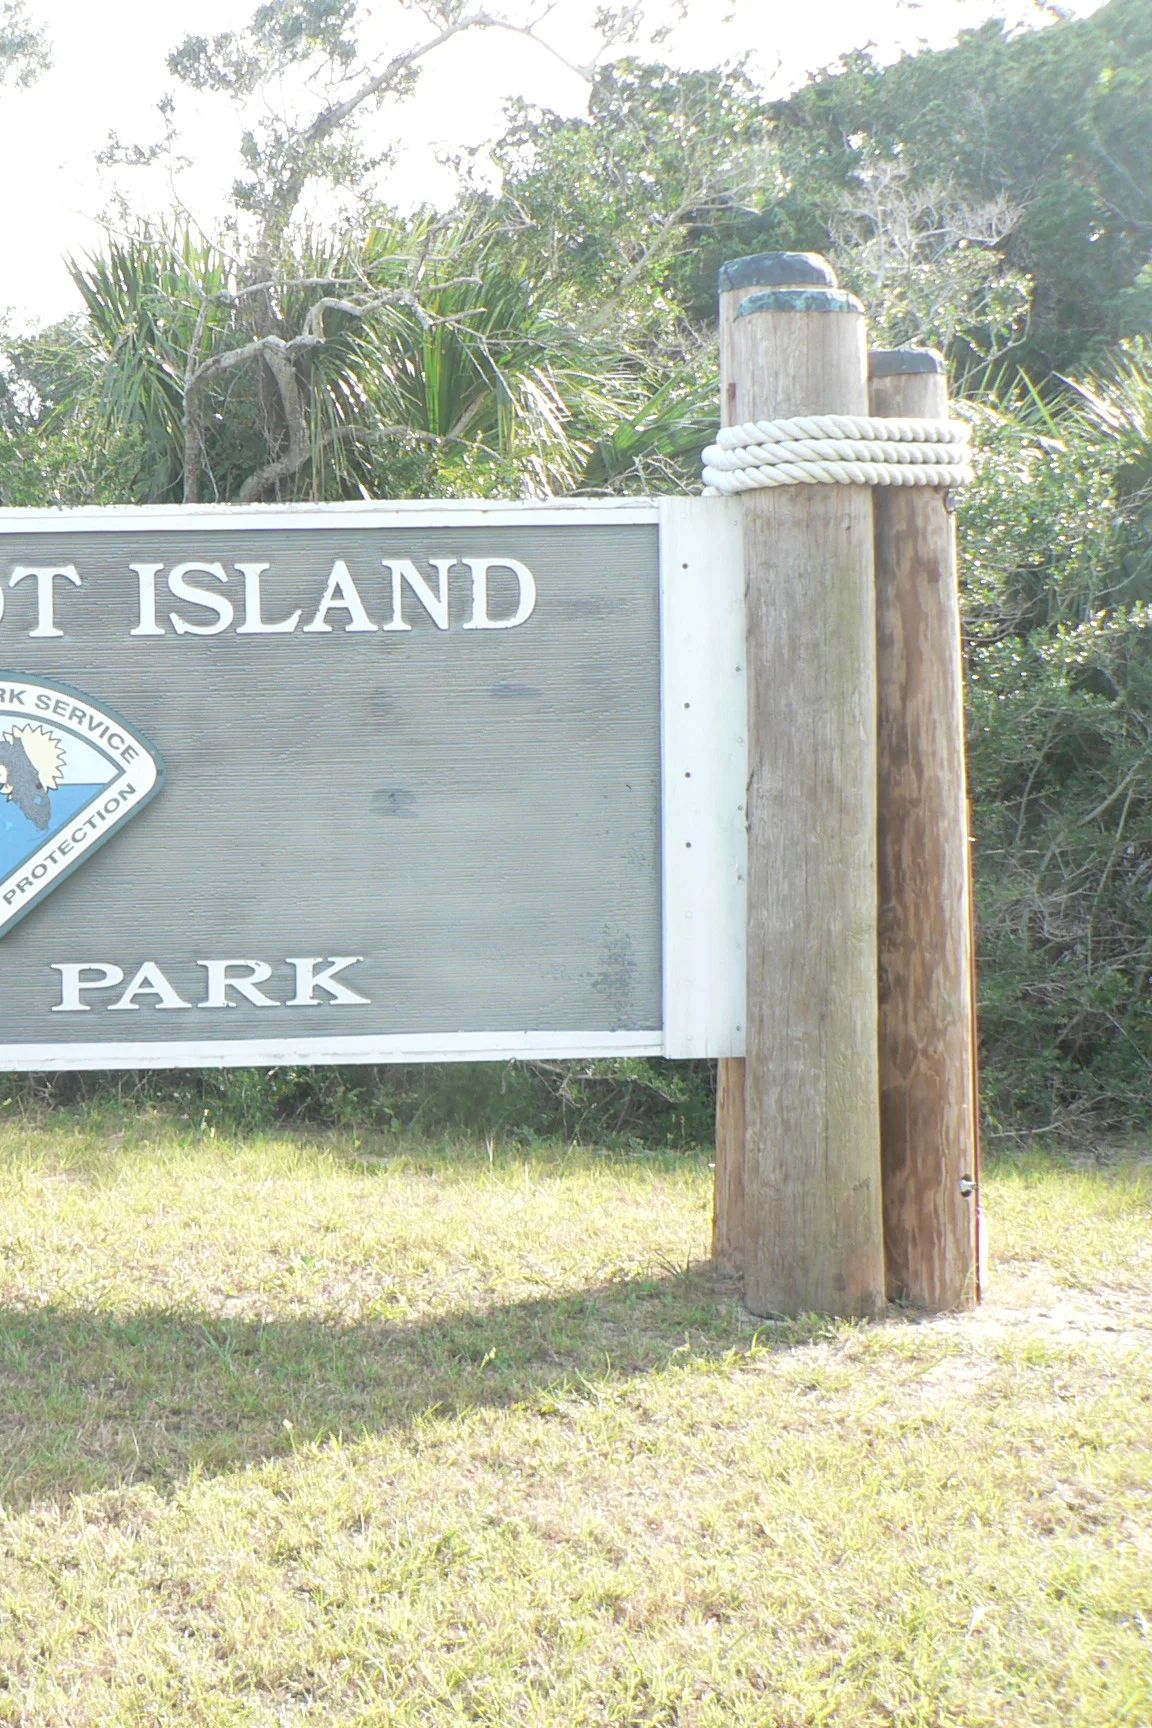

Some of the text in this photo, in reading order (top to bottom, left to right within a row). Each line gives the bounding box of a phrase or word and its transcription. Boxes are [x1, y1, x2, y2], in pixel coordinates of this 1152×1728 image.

[129, 557, 536, 637] ISLAND
[34, 694, 140, 765] SERVICE
[2, 782, 136, 906] PROTECTION
[51, 957, 371, 1012] PARK
